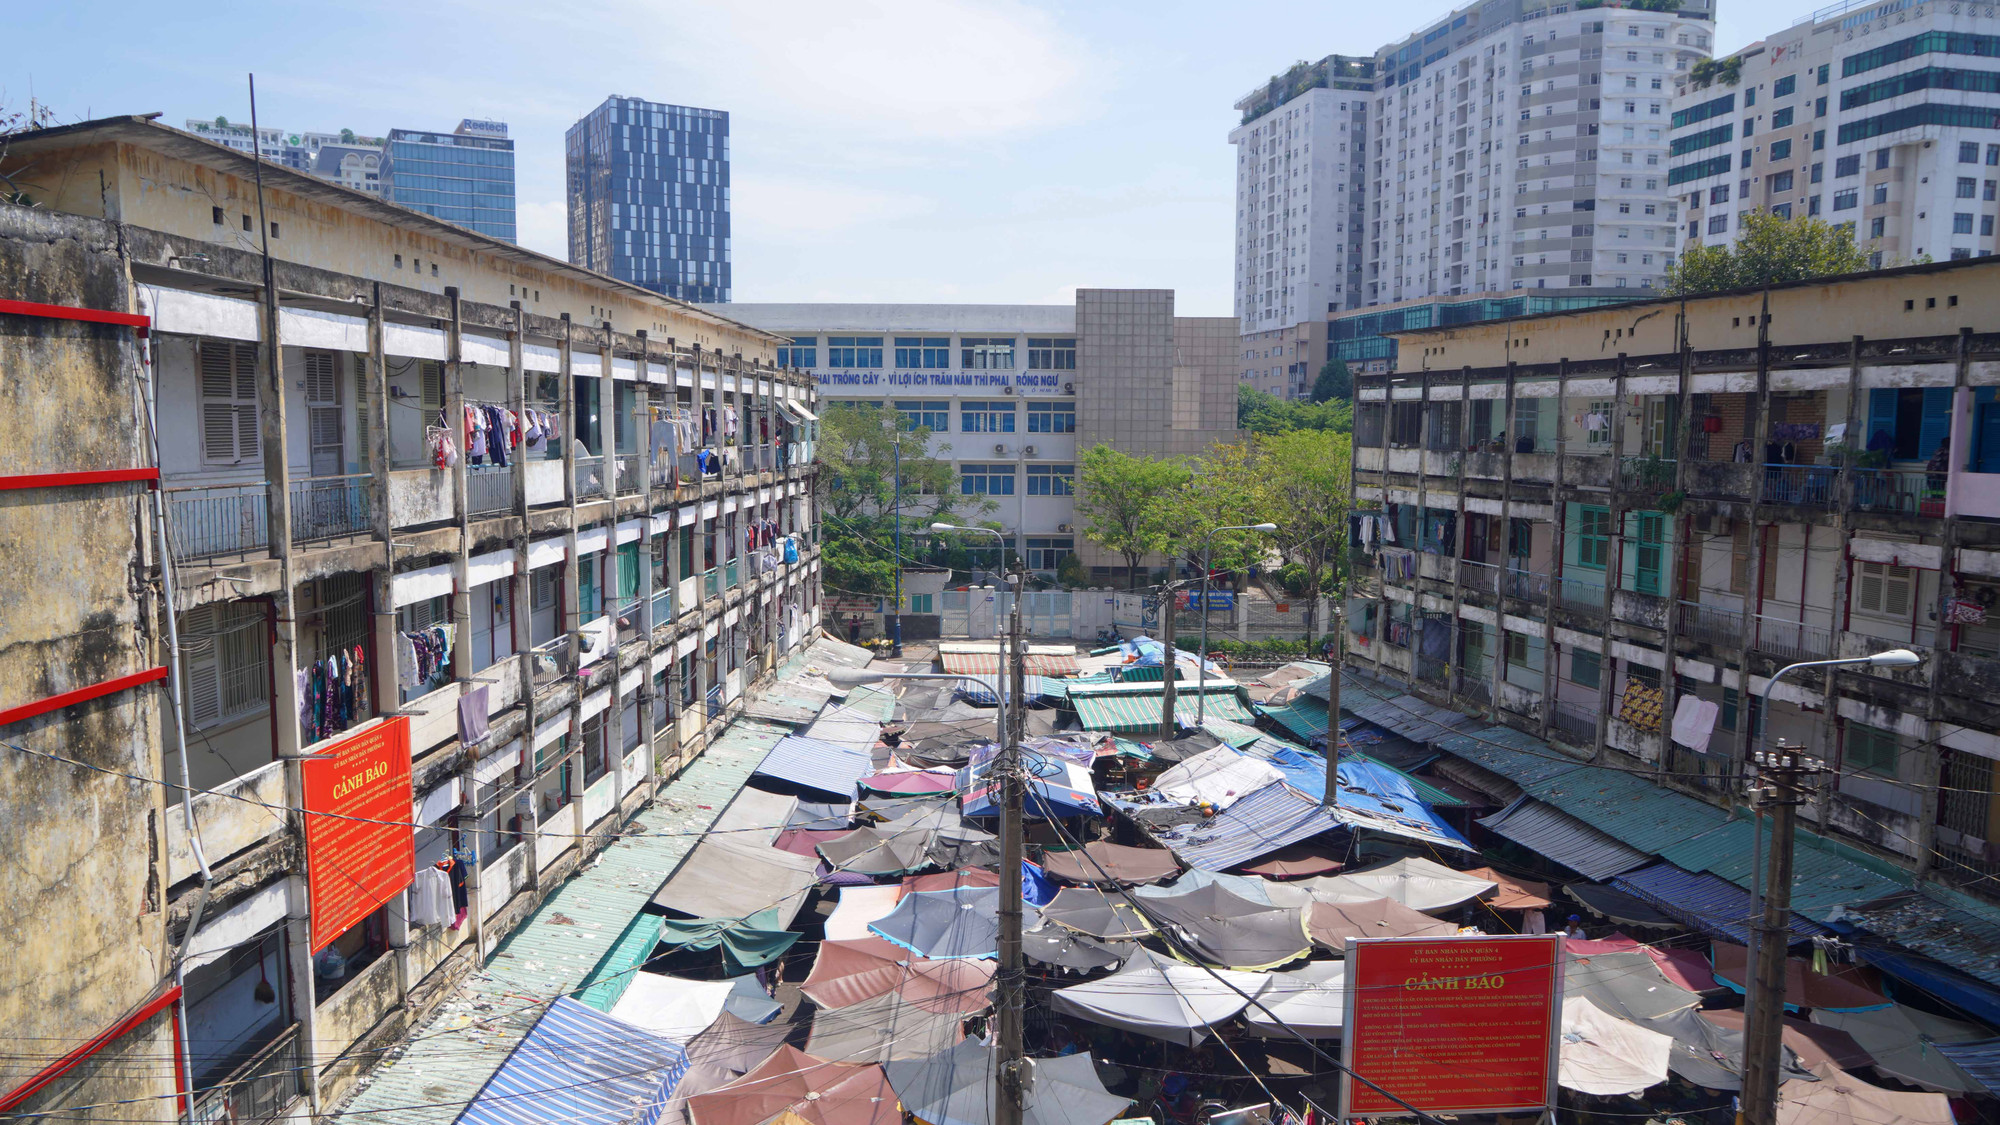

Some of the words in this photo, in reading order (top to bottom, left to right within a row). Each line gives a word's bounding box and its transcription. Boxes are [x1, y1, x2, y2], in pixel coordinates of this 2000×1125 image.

[464, 119, 507, 132] Reetech
[863, 371, 879, 384] CÂY
[888, 371, 896, 384] VÌ
[898, 372, 911, 388] LỢI
[914, 372, 927, 385] ÍCH
[930, 372, 952, 385] TRĂM
[954, 372, 972, 385] NĂM
[974, 372, 988, 386] THÌ
[333, 775, 363, 799] CẢNH
[365, 760, 387, 783] BÁO
[1405, 972, 1459, 990] CẢNH
[1464, 972, 1504, 989] BÁO
